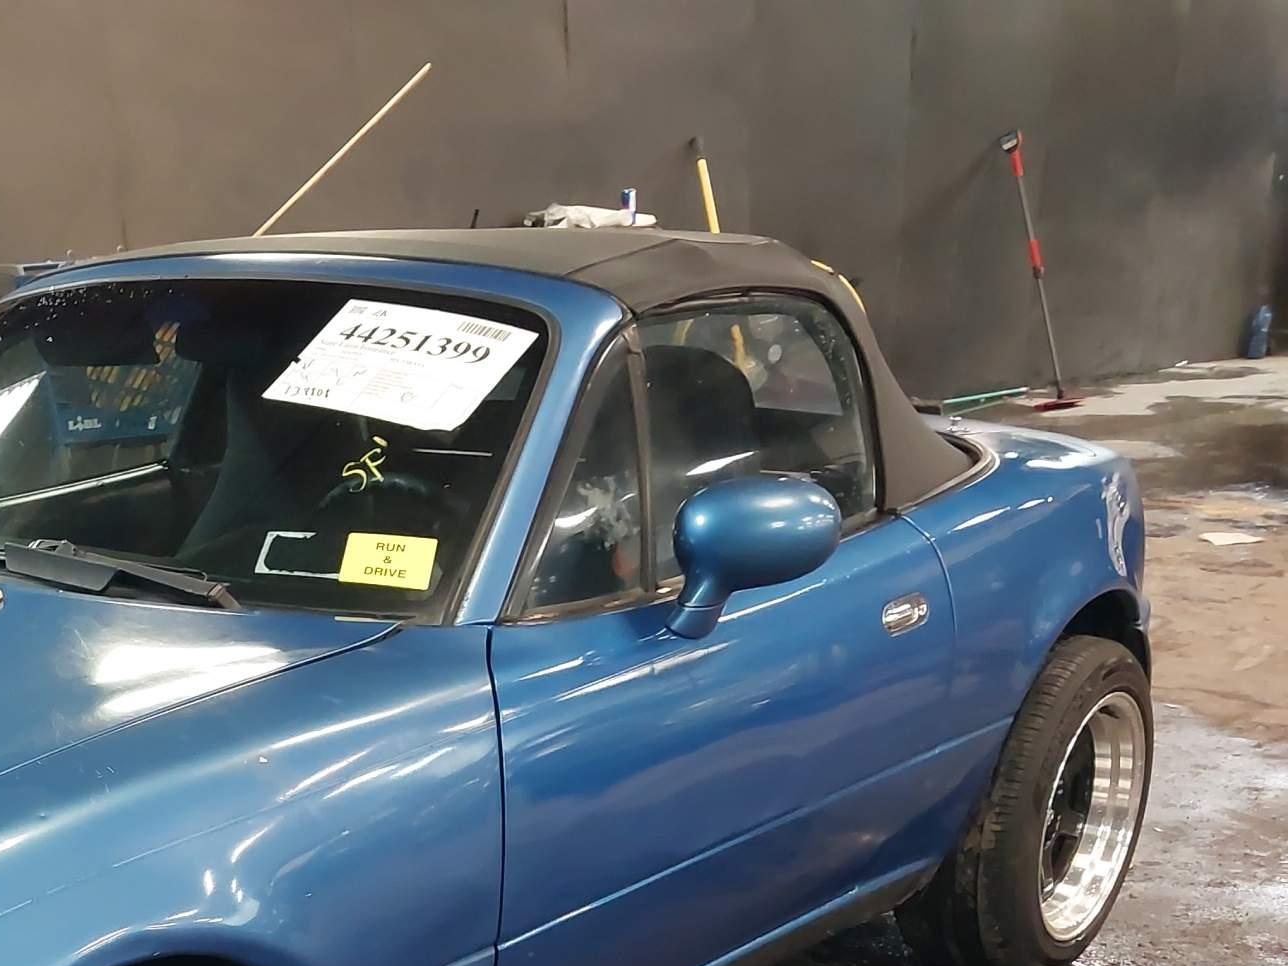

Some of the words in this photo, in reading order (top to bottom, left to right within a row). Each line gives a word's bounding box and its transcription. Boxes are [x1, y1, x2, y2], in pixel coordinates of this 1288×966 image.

[339, 323, 490, 364] 44251399
[376, 542, 406, 552] RUN
[383, 555, 392, 564] &
[364, 566, 407, 578] DRIVE
